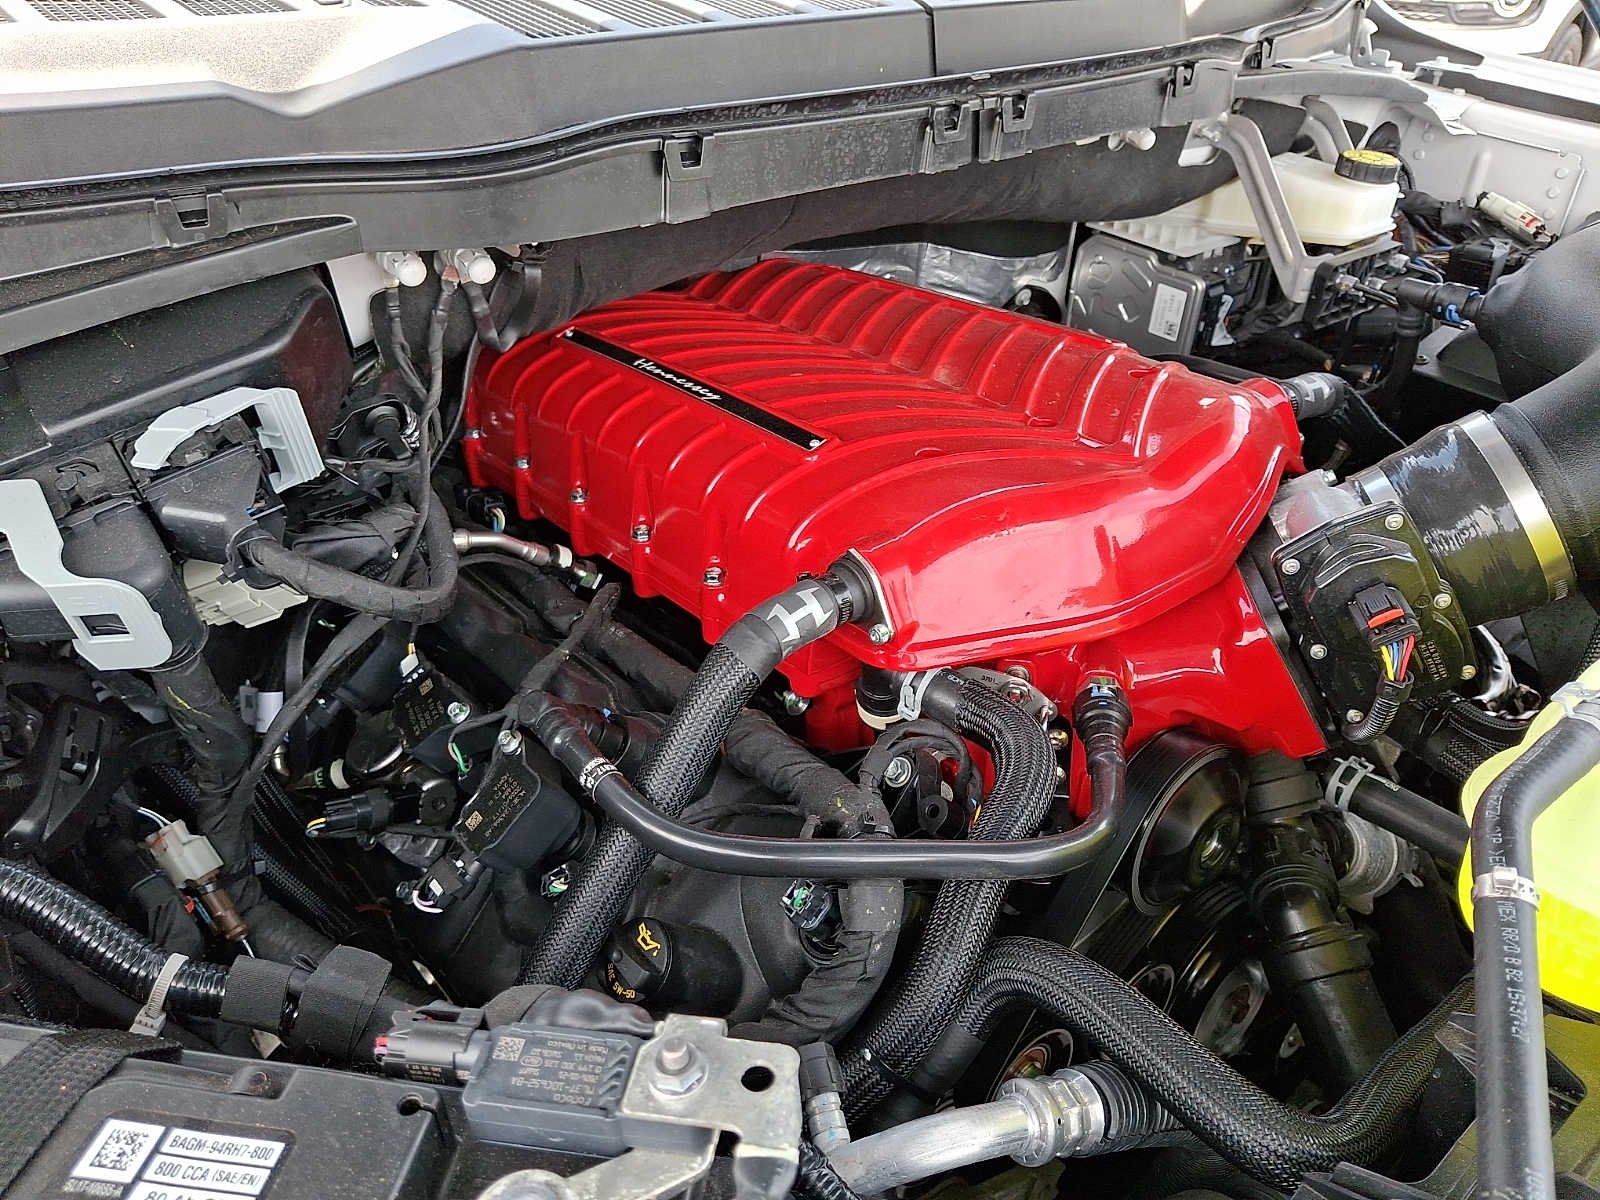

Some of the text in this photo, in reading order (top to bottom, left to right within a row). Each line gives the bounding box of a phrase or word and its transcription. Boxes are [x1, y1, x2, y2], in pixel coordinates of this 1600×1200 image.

[633, 358, 722, 401] Hennessey
[1496, 900, 1517, 922] MEX
[613, 981, 637, 999] 5W-50
[169, 1135, 275, 1161] BAGM-94RH7-800
[154, 1161, 262, 1187] 800 CCA (SAE/EN)
